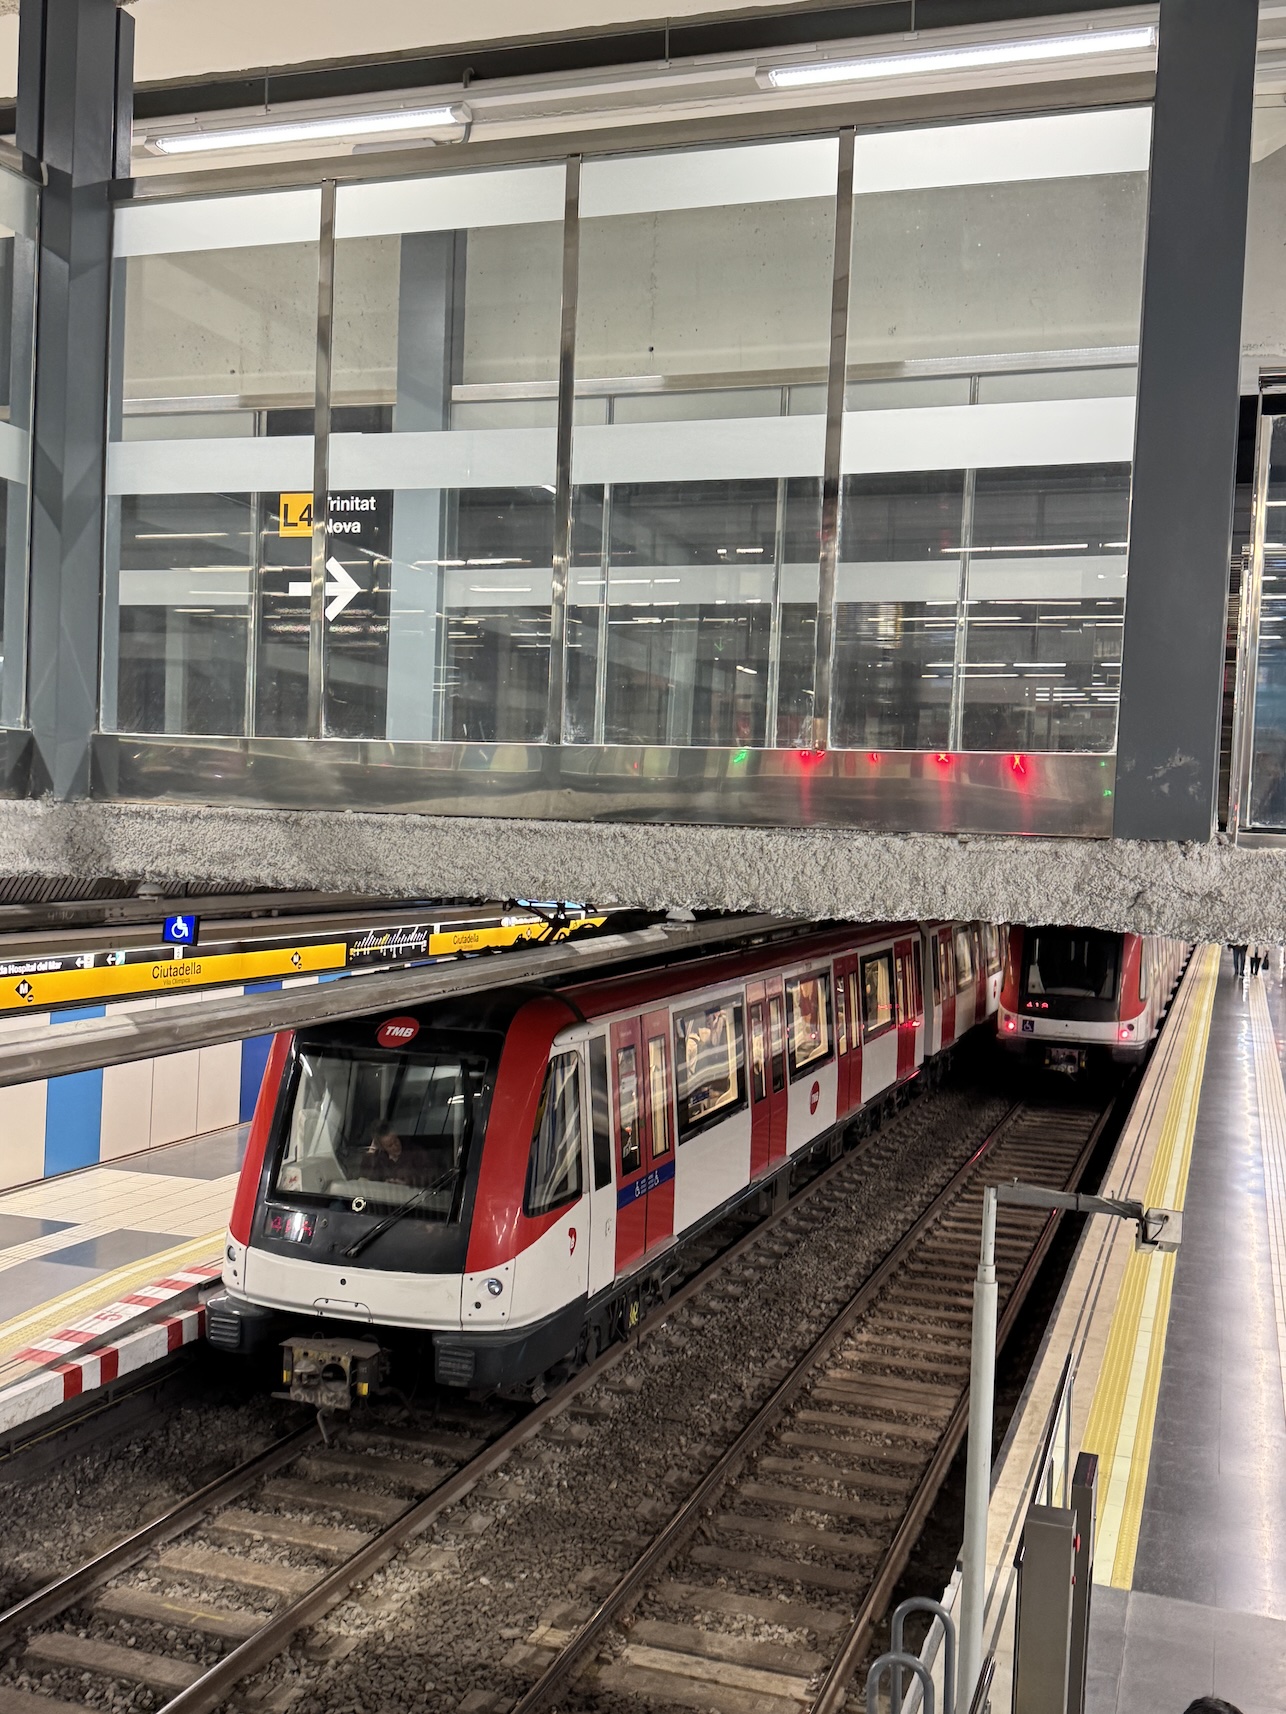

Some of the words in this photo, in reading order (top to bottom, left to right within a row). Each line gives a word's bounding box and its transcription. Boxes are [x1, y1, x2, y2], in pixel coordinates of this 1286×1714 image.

[283, 503, 313, 527] L4
[152, 962, 202, 979] Ciutadella
[385, 1025, 415, 1038] TMB
